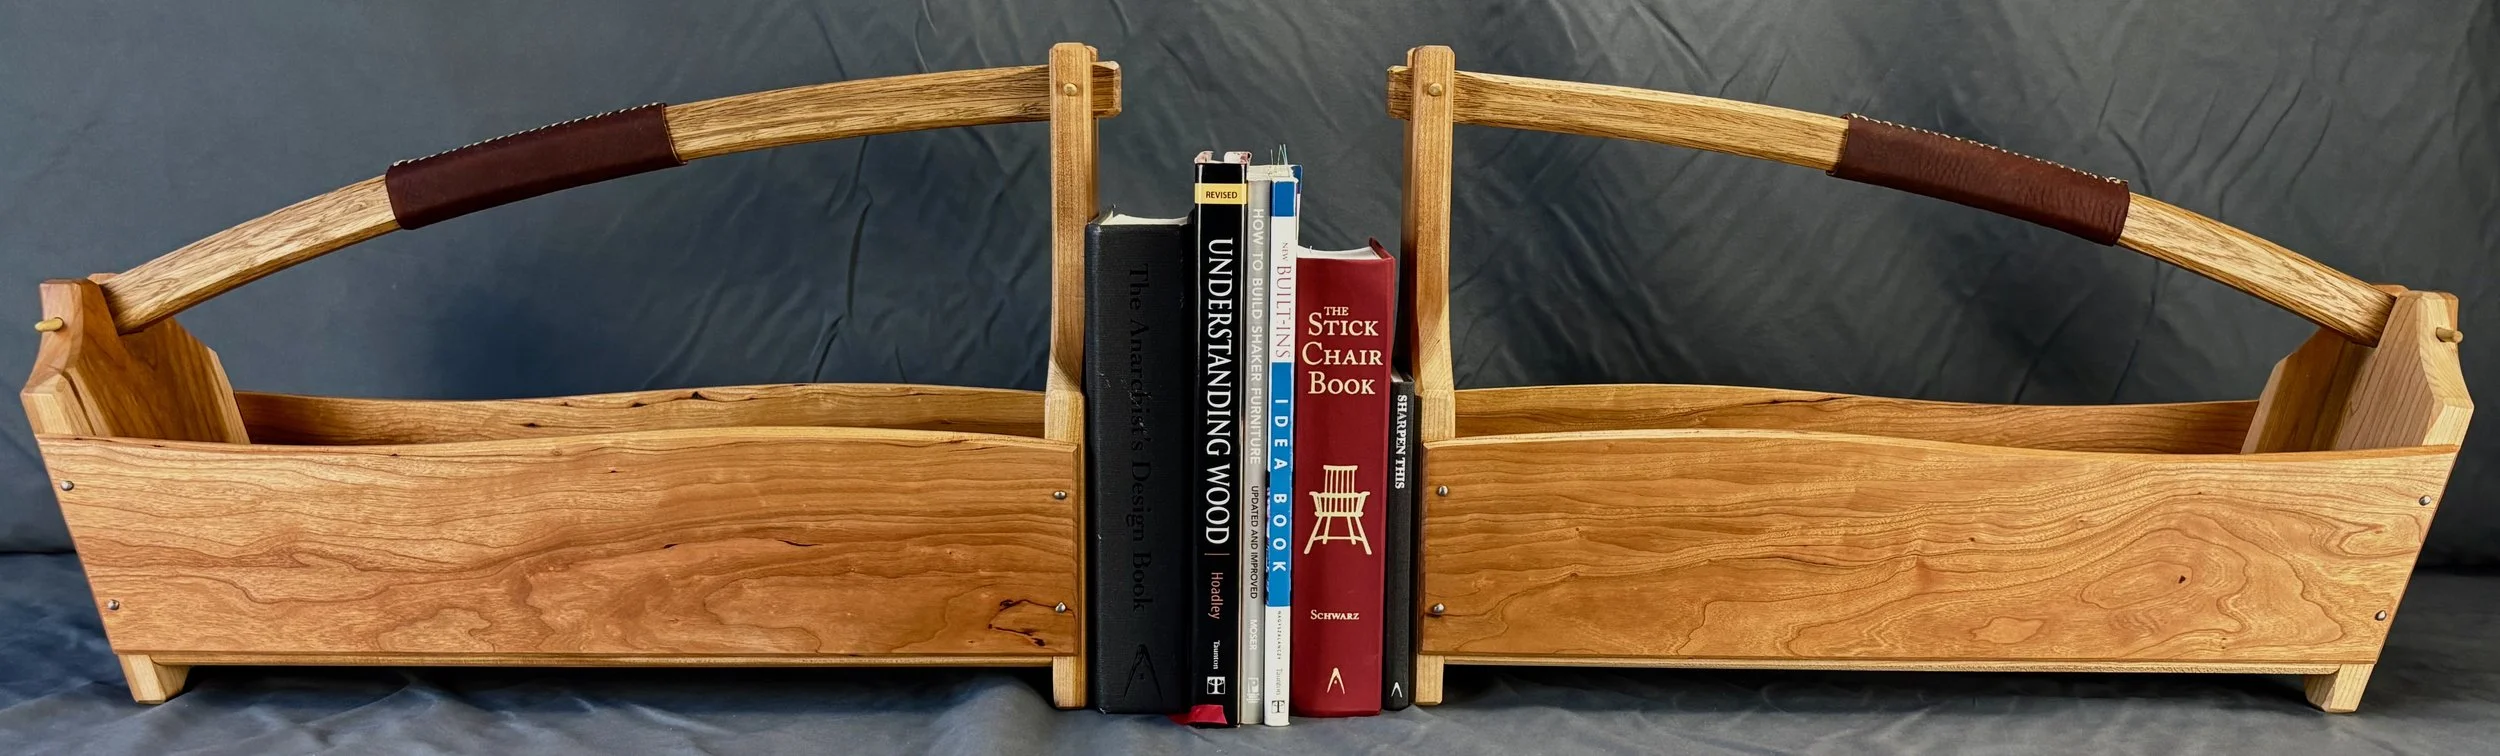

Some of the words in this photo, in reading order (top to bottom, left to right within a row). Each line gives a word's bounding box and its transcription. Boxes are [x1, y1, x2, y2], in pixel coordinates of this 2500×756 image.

[1206, 191, 1238, 199] REVISED
[1252, 208, 1264, 245] HOW
[1252, 250, 1264, 272] TO
[1130, 263, 1150, 310] The
[1252, 278, 1263, 320] BUILD
[1276, 266, 1291, 358] BUILT-INS
[1308, 312, 1379, 336] STICK
[1324, 306, 1349, 316] THE
[1206, 237, 1233, 456] UNDERSTANDING
[1250, 326, 1262, 381] SHAKER
[1302, 341, 1383, 366] CHAIR
[1130, 318, 1153, 451] Anarchist's
[1308, 371, 1376, 395] BOOK
[1250, 388, 1262, 464] FURNITURE
[1274, 399, 1288, 470] IDEA
[1395, 394, 1407, 455] SHARPEN
[1395, 458, 1406, 489] THIS
[1125, 461, 1152, 542] Design
[1206, 463, 1230, 544] WOOD
[1251, 486, 1259, 528] UPDATED
[1272, 494, 1287, 572] BOOK
[1132, 552, 1153, 612] Book
[1208, 572, 1224, 619] Hoadley
[1250, 552, 1258, 599] IMPROVED
[1249, 619, 1258, 650] MOSER
[1310, 610, 1360, 621] SCHWARZ
